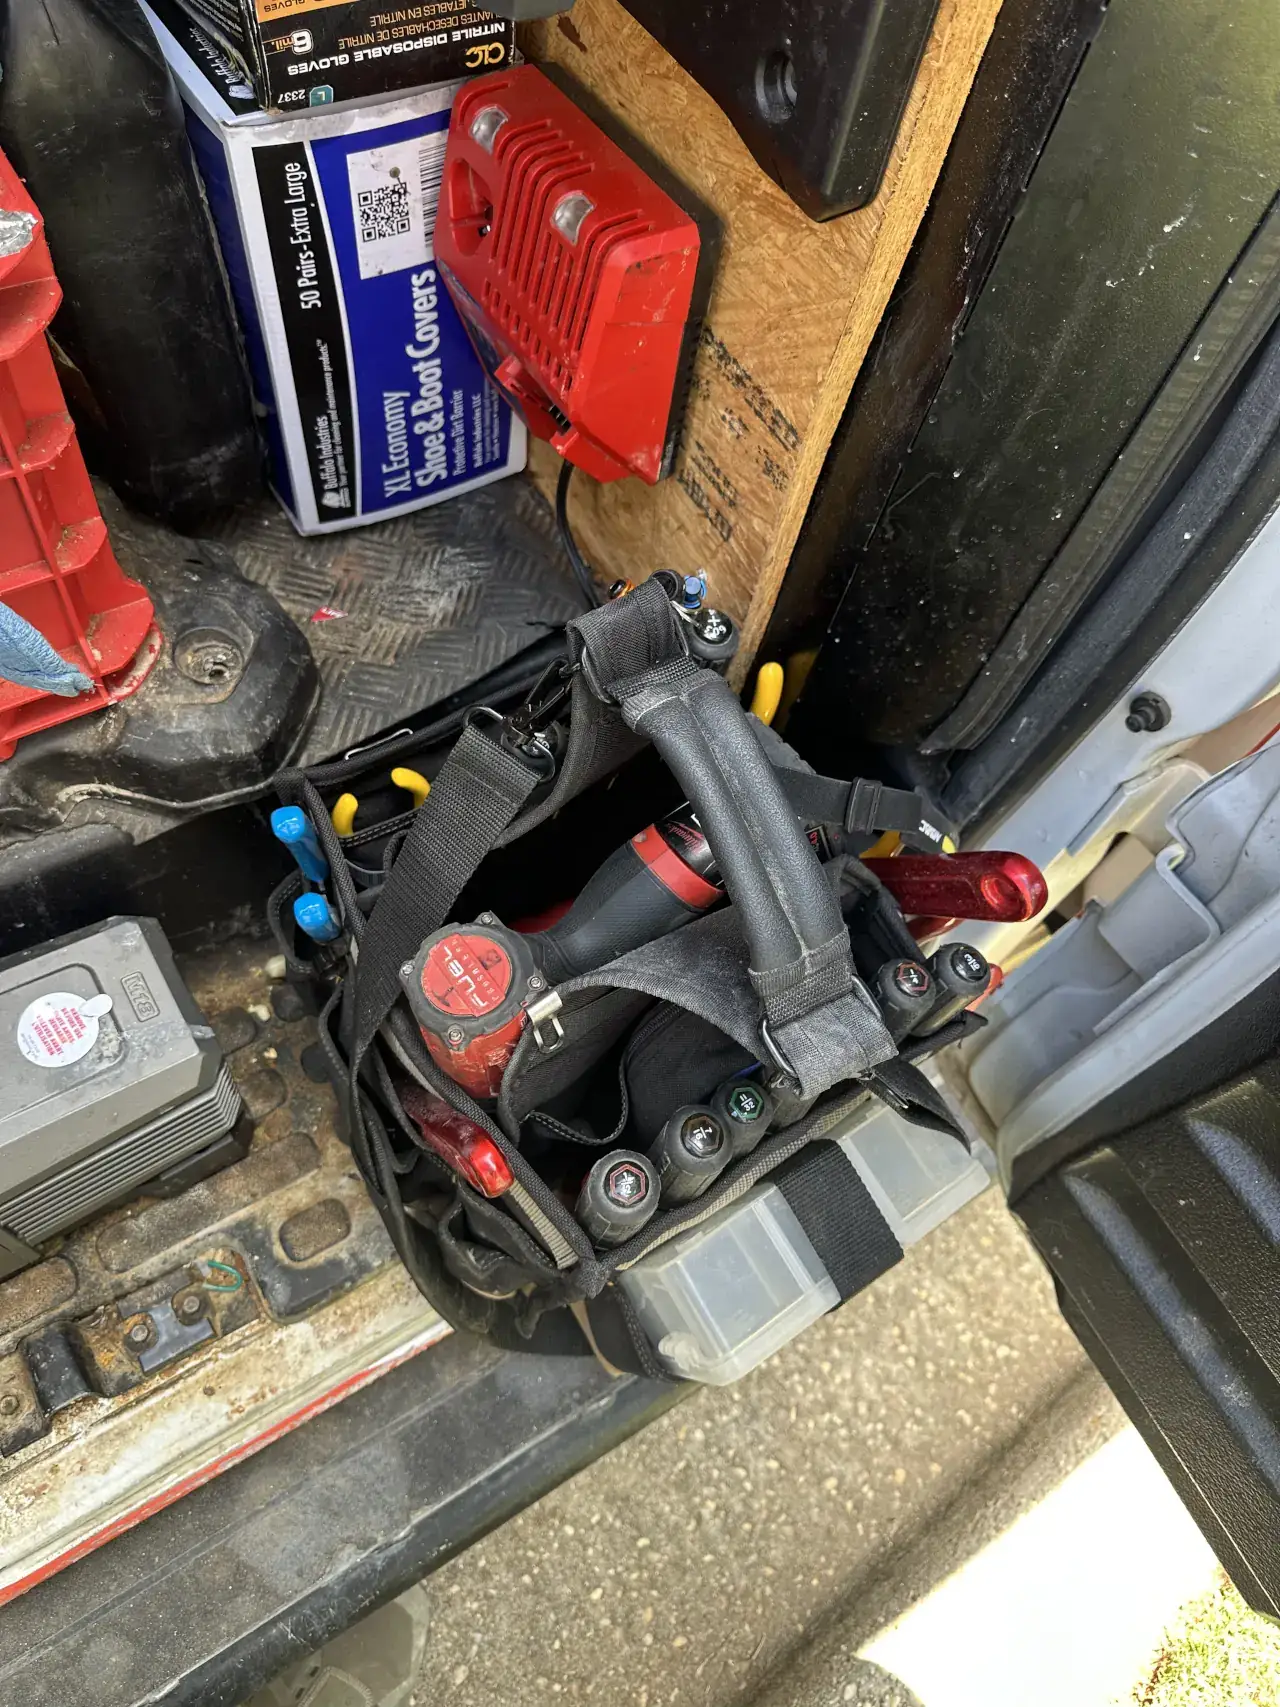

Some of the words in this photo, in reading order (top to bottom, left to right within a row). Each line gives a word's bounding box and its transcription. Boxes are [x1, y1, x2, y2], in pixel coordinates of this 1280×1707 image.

[369, 10, 406, 27] NITRILE
[408, 7, 422, 18] EN
[376, 29, 390, 39] DE
[391, 15, 459, 39] DESECHABLES
[452, 22, 505, 41] NITRILE
[338, 33, 375, 49] NITRILE
[354, 33, 448, 62] DISPOSABLE
[287, 54, 350, 76] GLOVES
[465, 42, 505, 68] CLC
[277, 89, 306, 104] 2337
[317, 91, 326, 101] L
[284, 162, 308, 204] Large
[300, 291, 322, 309] 50
[405, 268, 441, 359] Covers
[324, 372, 336, 409] maintenance
[411, 357, 444, 417] Boot
[471, 392, 481, 408] LLC
[327, 409, 339, 422] and
[449, 389, 464, 421] Barrier
[382, 391, 411, 474] Economy
[413, 410, 445, 435] &
[451, 419, 464, 438] Dirt
[471, 407, 482, 443] Industries
[315, 415, 334, 459] Industries
[415, 431, 447, 488] Shoe
[452, 435, 466, 476] Protective
[472, 442, 483, 468] Buffalo
[320, 458, 339, 490] Buffalo
[384, 470, 412, 497] XL
[443, 945, 489, 1008] FUEL
[123, 975, 155, 1016] M18
[61, 1007, 77, 1028] BEFORE
[73, 1027, 83, 1039] USE
[70, 1008, 86, 1030] REMOVE
[62, 1026, 75, 1044] ANTES
